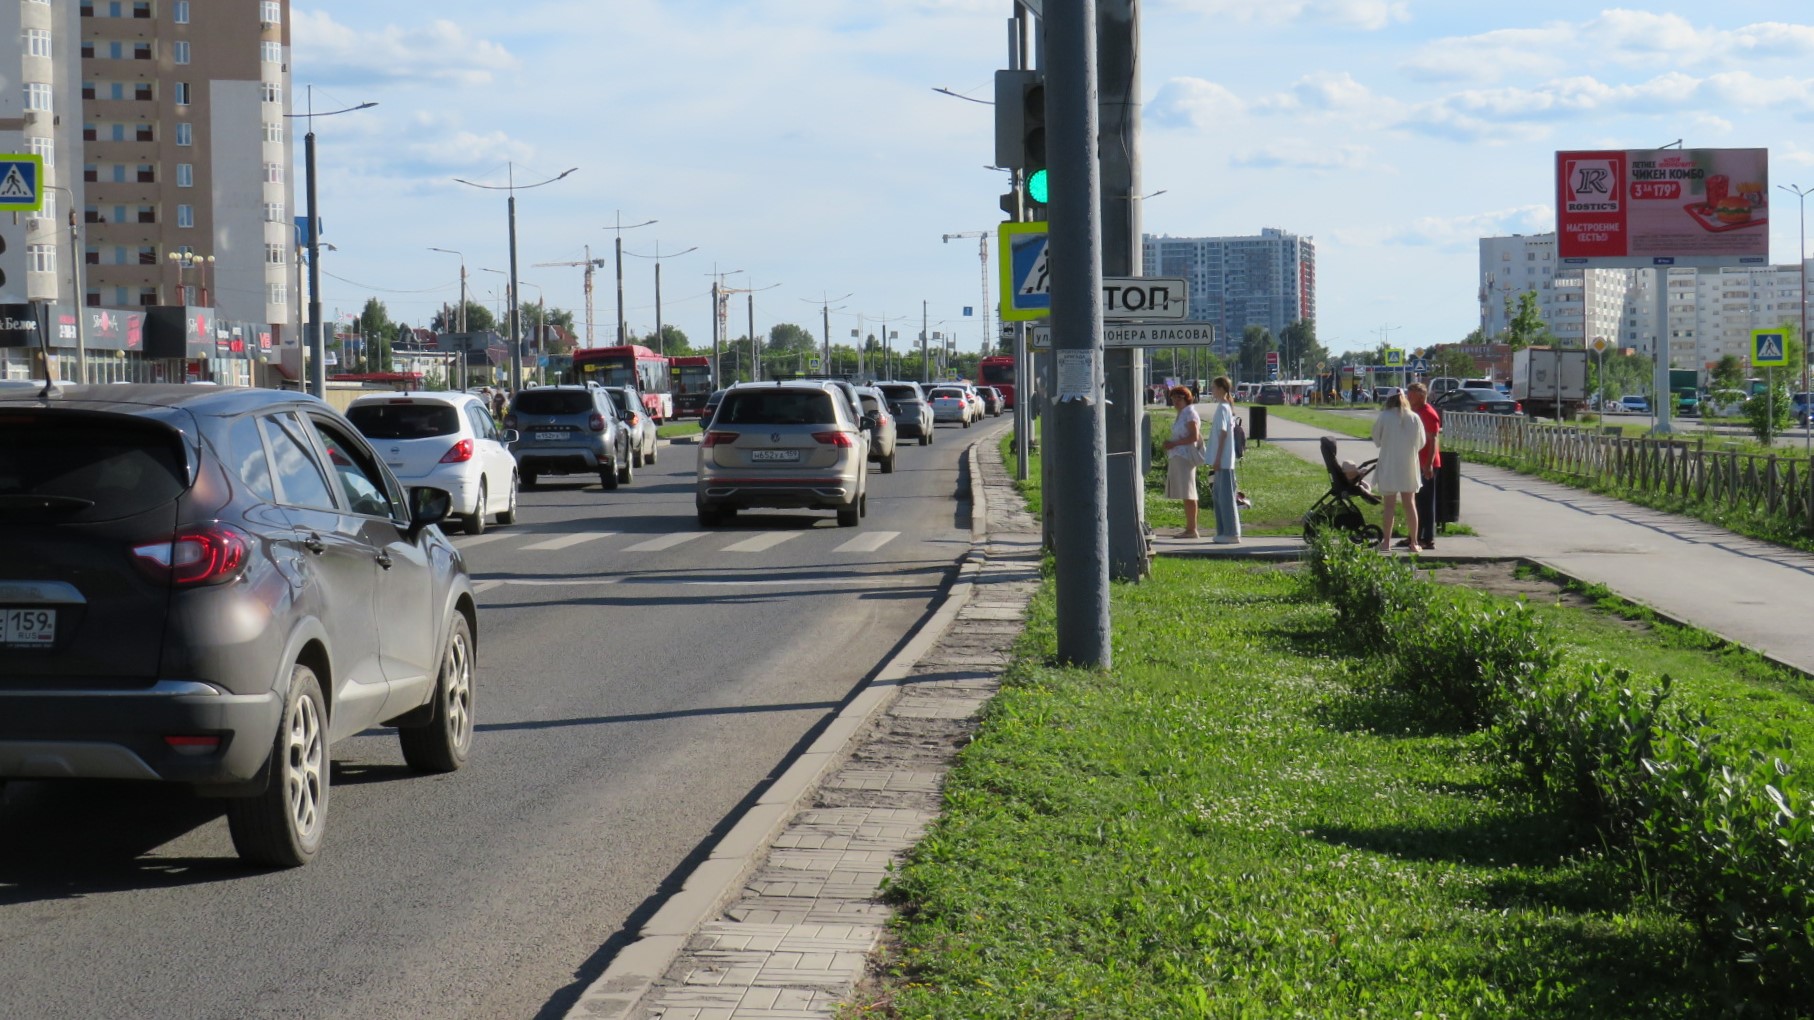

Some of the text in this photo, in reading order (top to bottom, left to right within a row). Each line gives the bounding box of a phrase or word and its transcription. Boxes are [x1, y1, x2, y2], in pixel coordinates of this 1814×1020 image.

[1632, 168, 1705, 180] ЧИКЕН КОМБО
[1634, 184, 1643, 197] 3
[1568, 203, 1617, 211] ROSTIC'S
[1566, 223, 1620, 233] НАСТРОЕНИЕ
[1103, 286, 1169, 312] ТОП
[1152, 329, 1209, 340] ВЛАСОВА
[10, 612, 49, 632] 159
